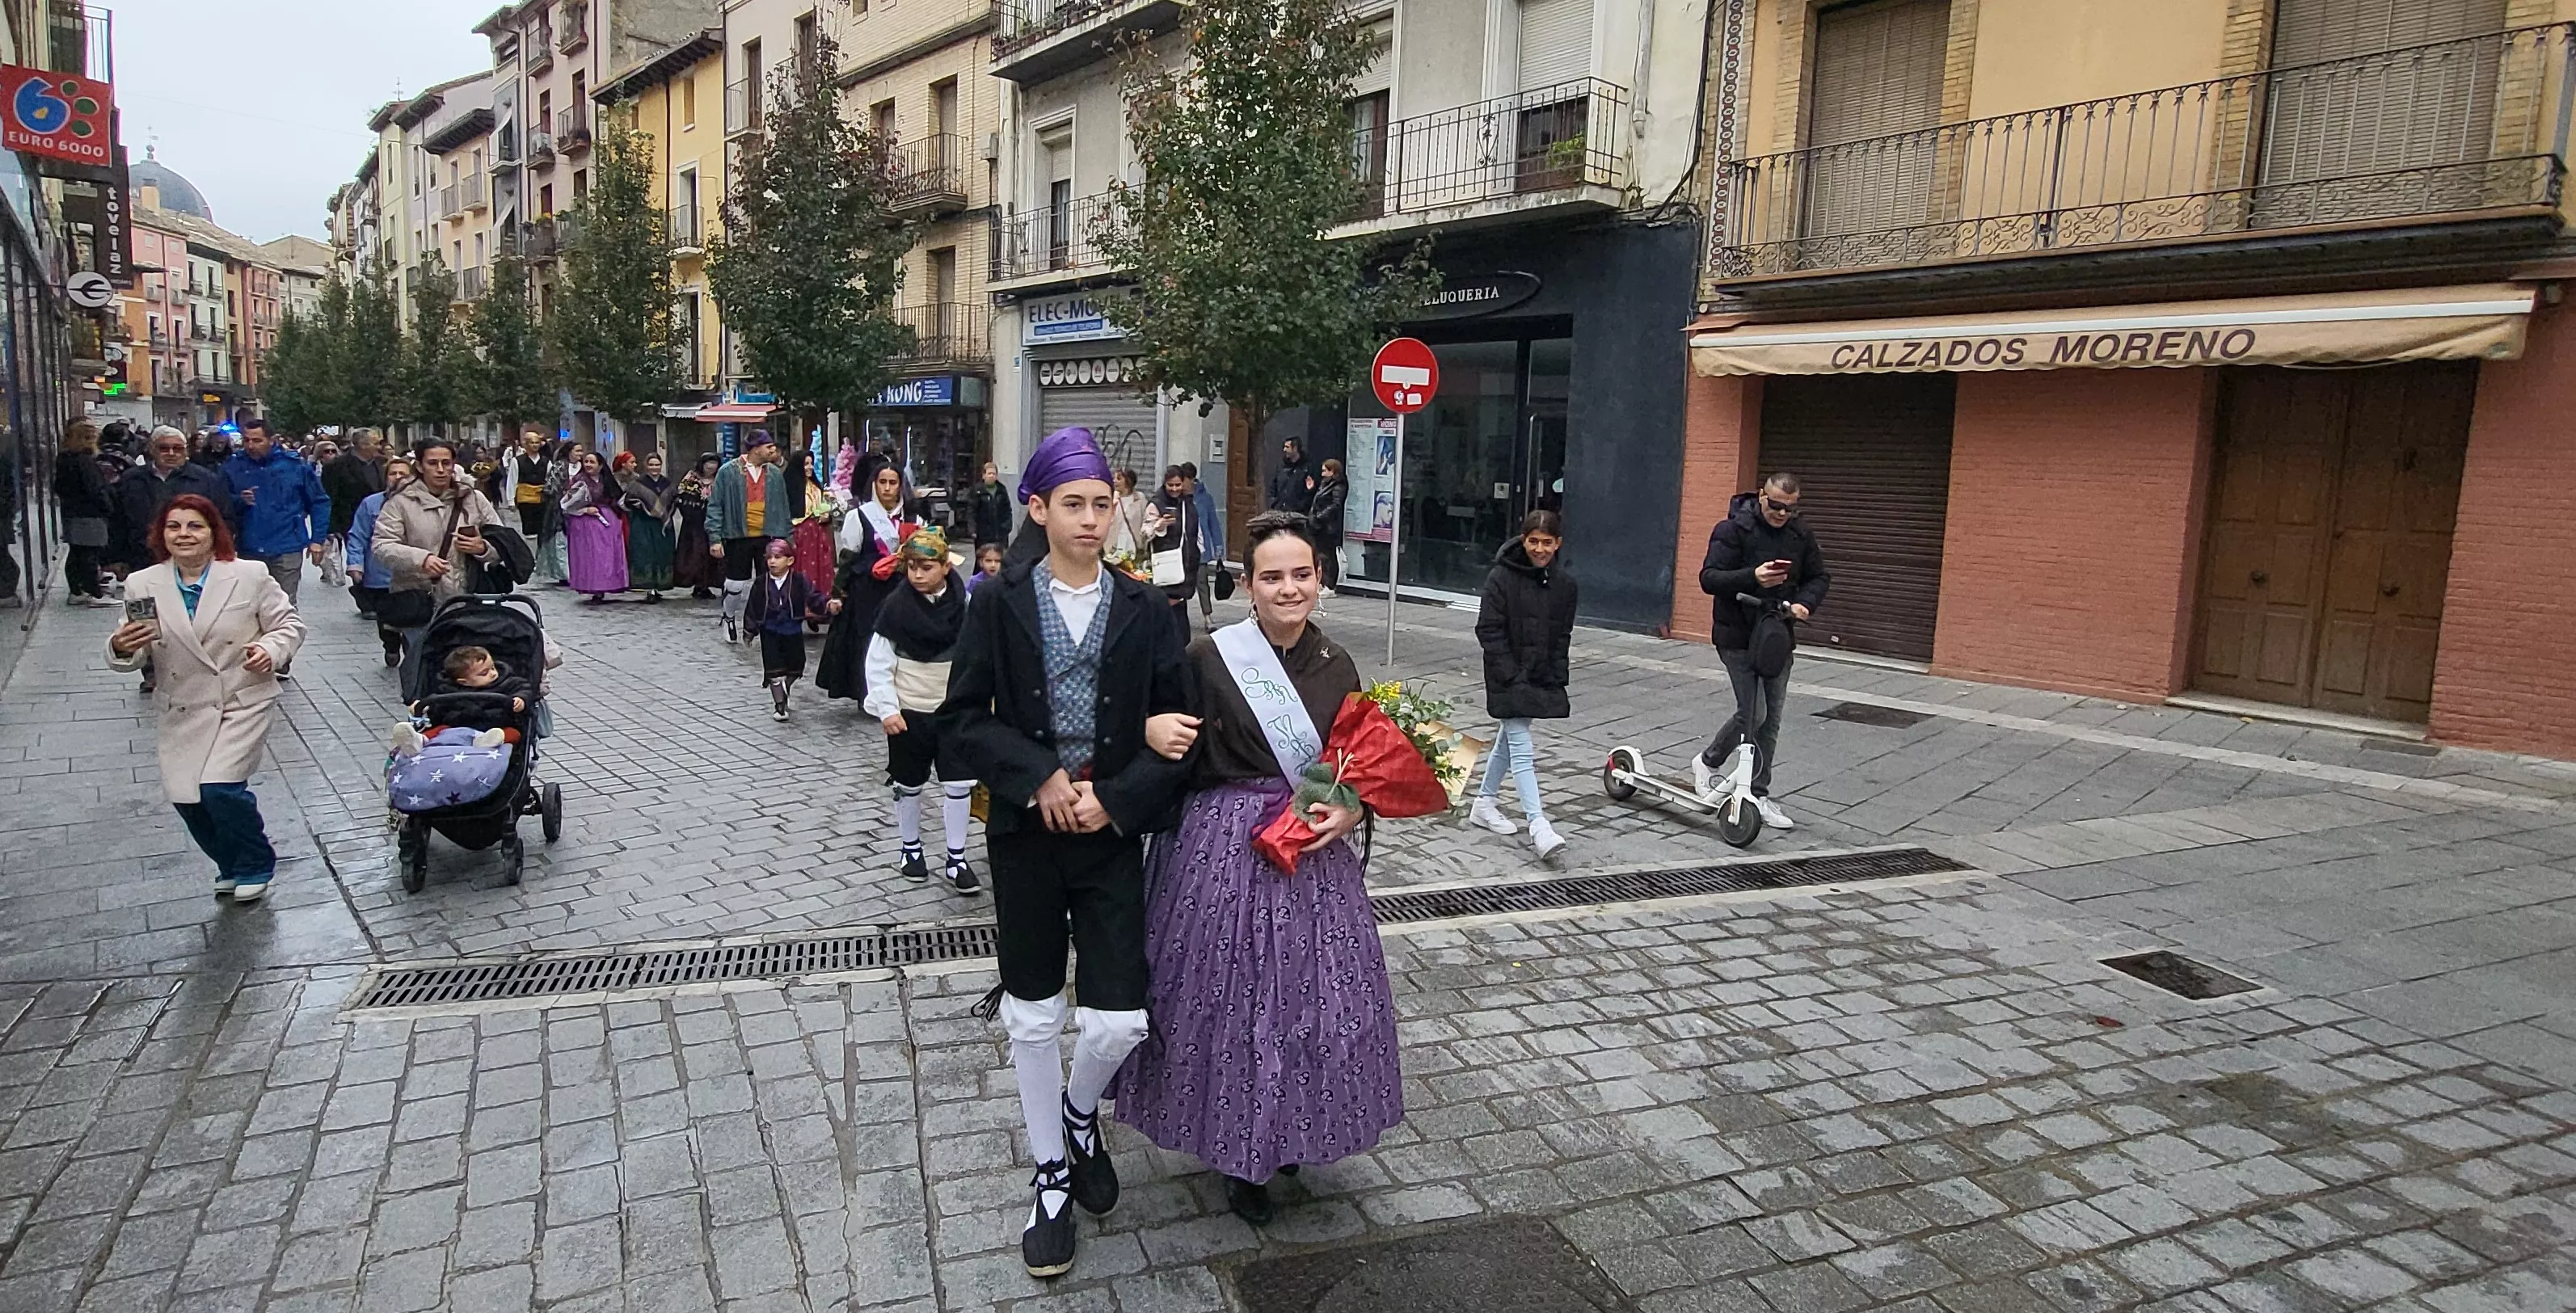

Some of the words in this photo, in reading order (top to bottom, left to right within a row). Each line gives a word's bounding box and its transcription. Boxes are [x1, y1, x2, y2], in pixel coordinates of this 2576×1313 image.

[8, 131, 54, 149] EURO
[58, 141, 104, 158] 6000
[107, 187, 122, 275] tovelaz
[1418, 285, 1500, 306] ELUQUERIA
[1830, 338, 2026, 369] CALZADOS
[2049, 329, 2256, 364] MORENO
